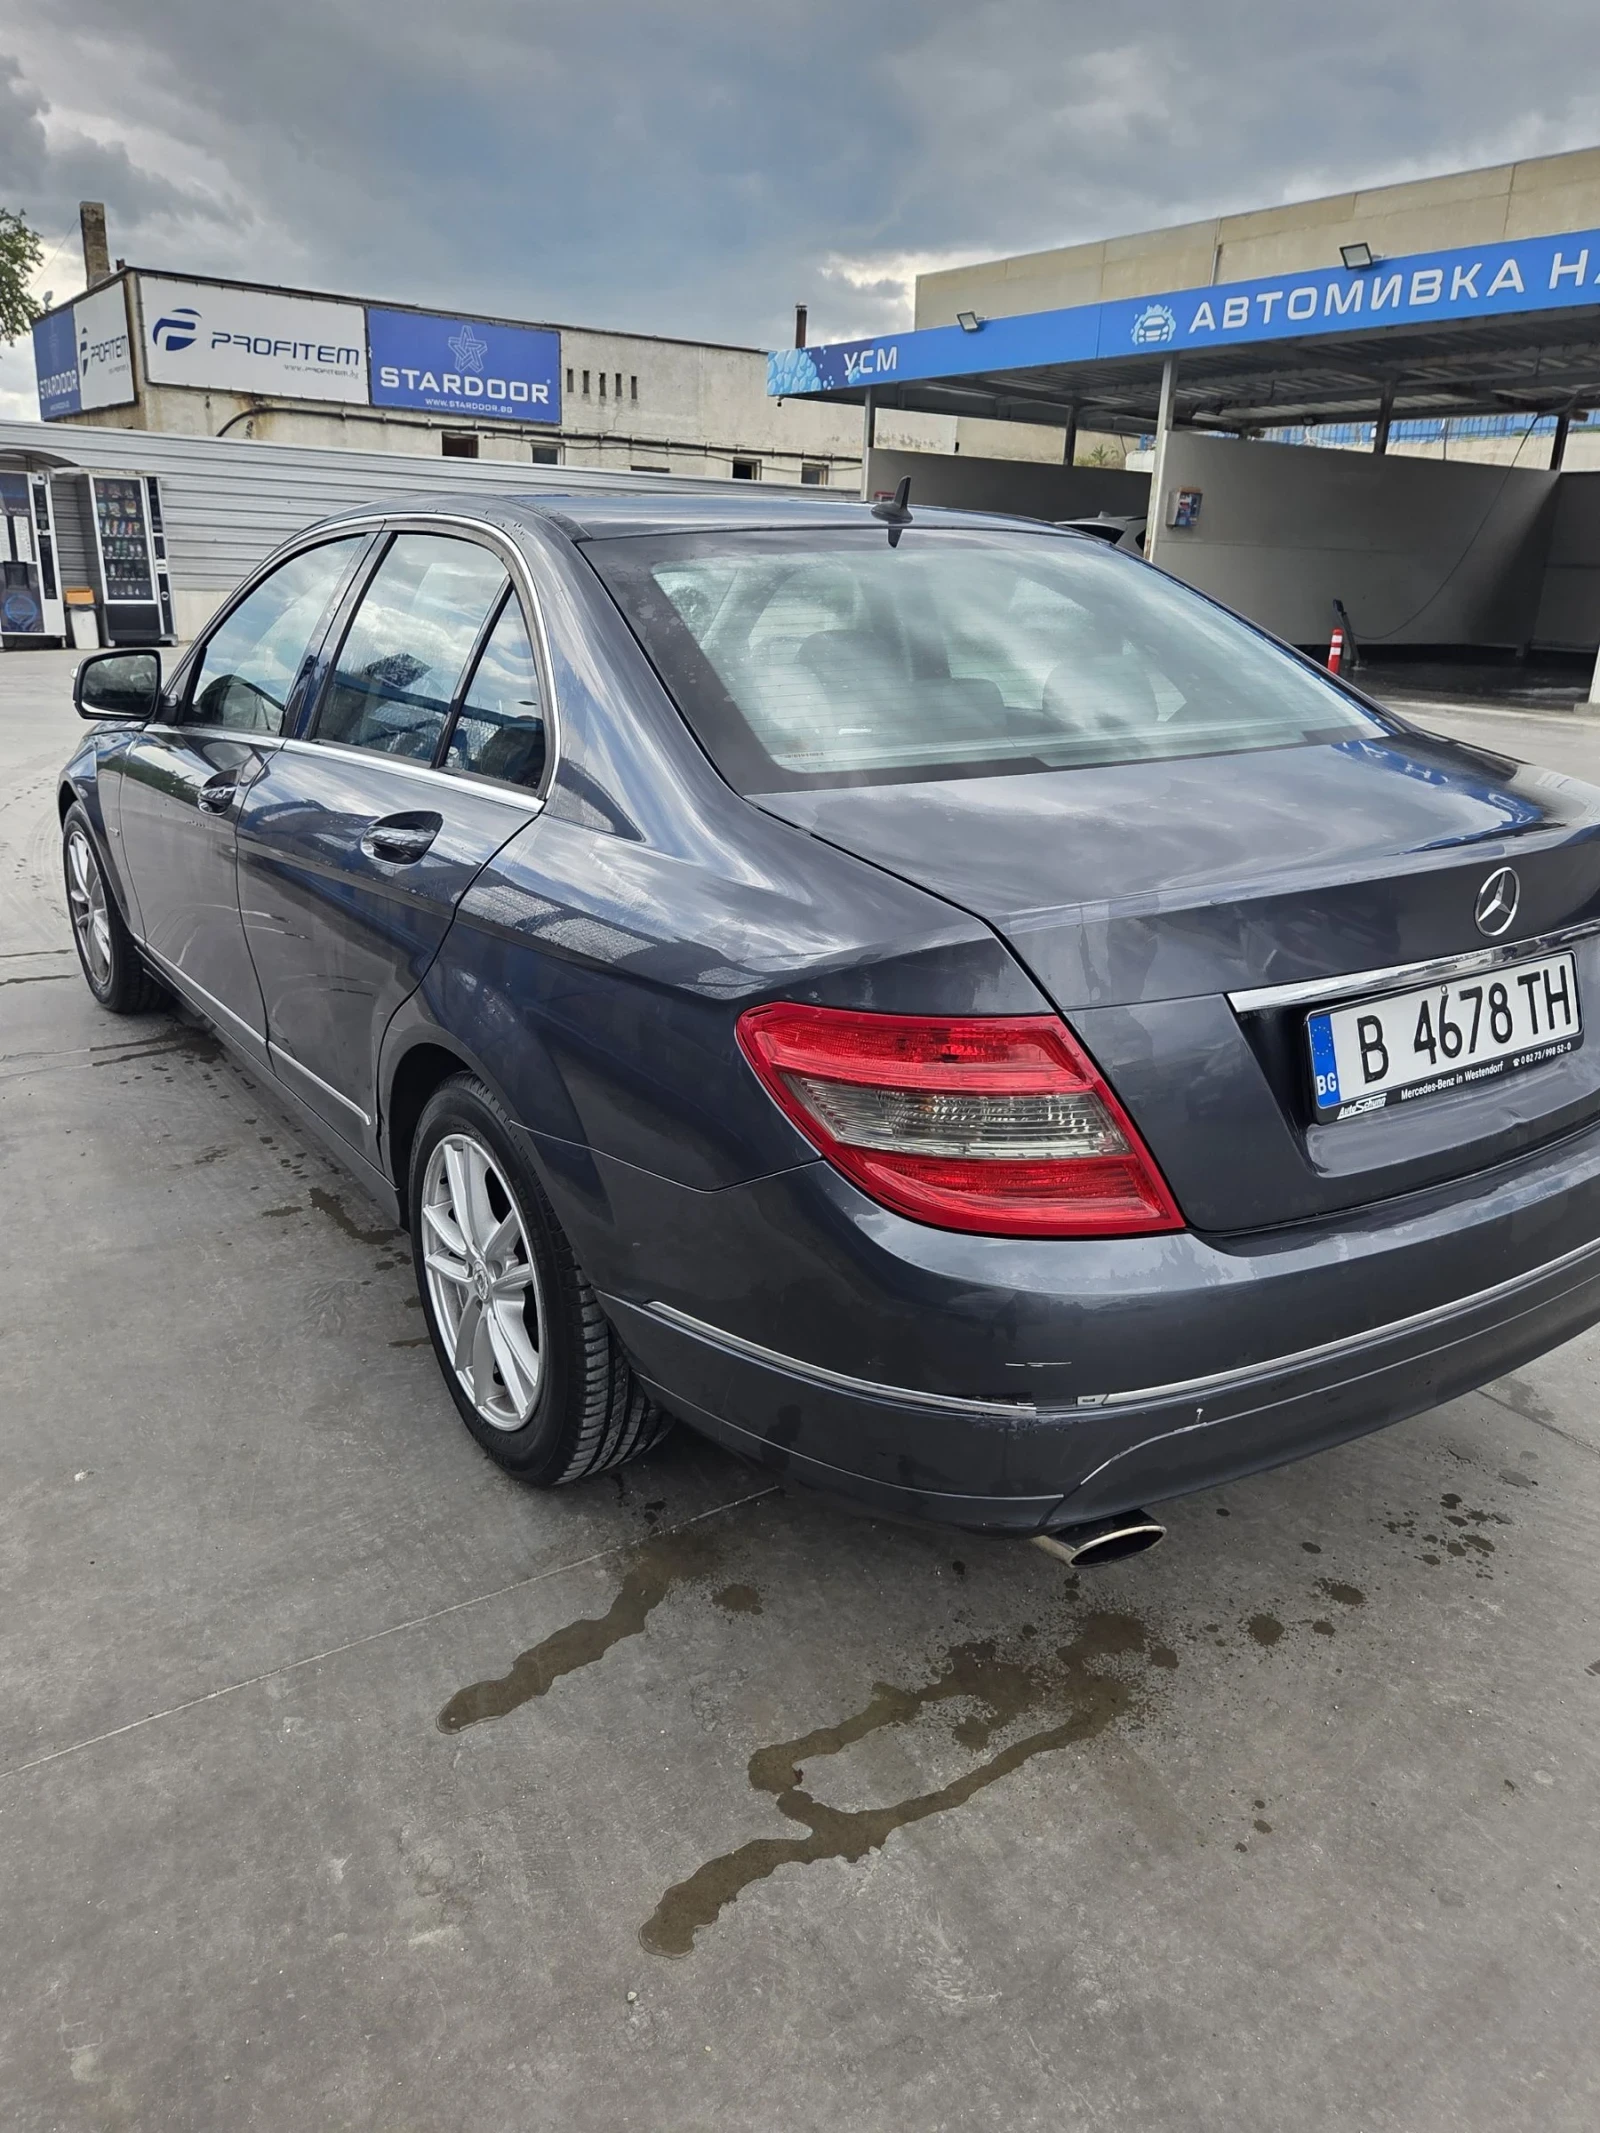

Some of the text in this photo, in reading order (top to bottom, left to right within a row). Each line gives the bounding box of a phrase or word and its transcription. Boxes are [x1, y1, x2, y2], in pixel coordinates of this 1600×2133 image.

[1189, 249, 1600, 334] АВТОМИВКА Н
[211, 331, 360, 365] PROFITEM
[843, 347, 897, 376] УСМ
[380, 366, 549, 404] STARDOOR
[1357, 965, 1572, 1084] B 4678 TH
[1316, 1074, 1338, 1096] BG
[1401, 1061, 1503, 1100] Mercedes-Benz in Westendorf
